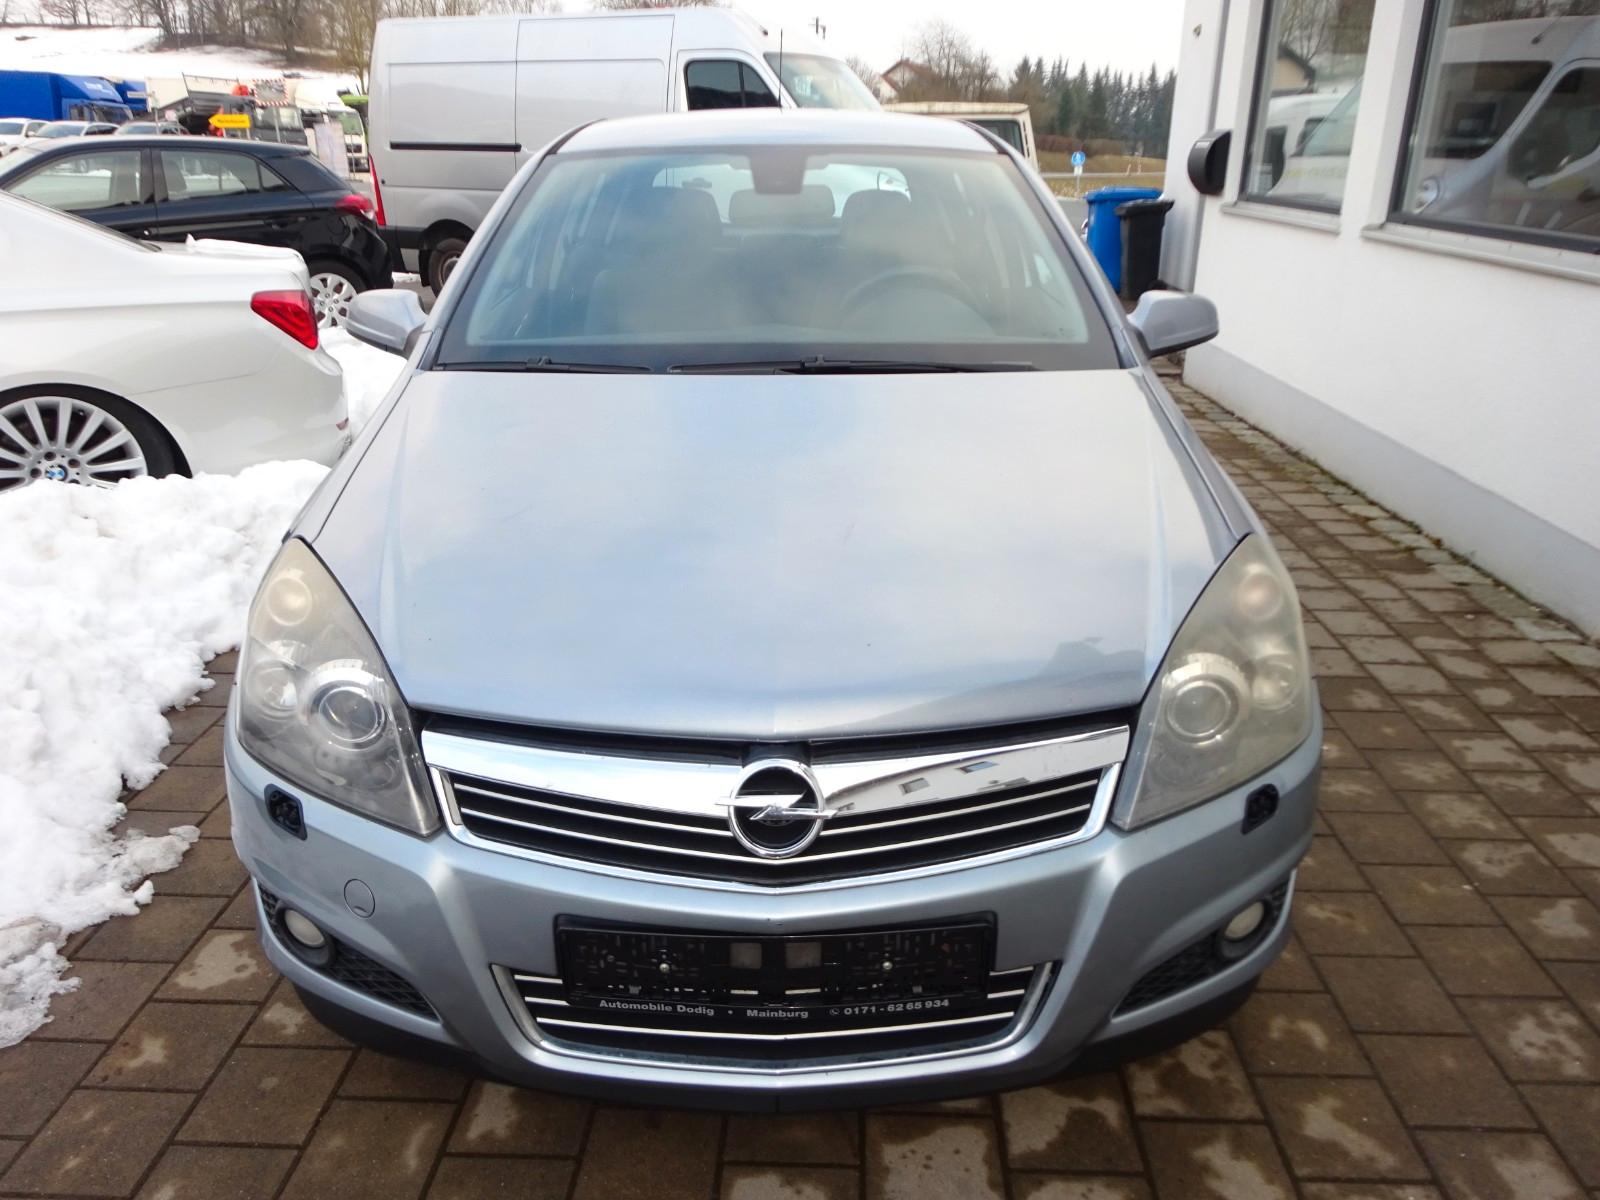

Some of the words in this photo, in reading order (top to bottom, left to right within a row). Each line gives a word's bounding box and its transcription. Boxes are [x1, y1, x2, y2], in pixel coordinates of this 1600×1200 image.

[599, 999, 673, 1012] Automobile
[676, 1004, 715, 1016] Dodig
[746, 1009, 809, 1019] Mainburg
